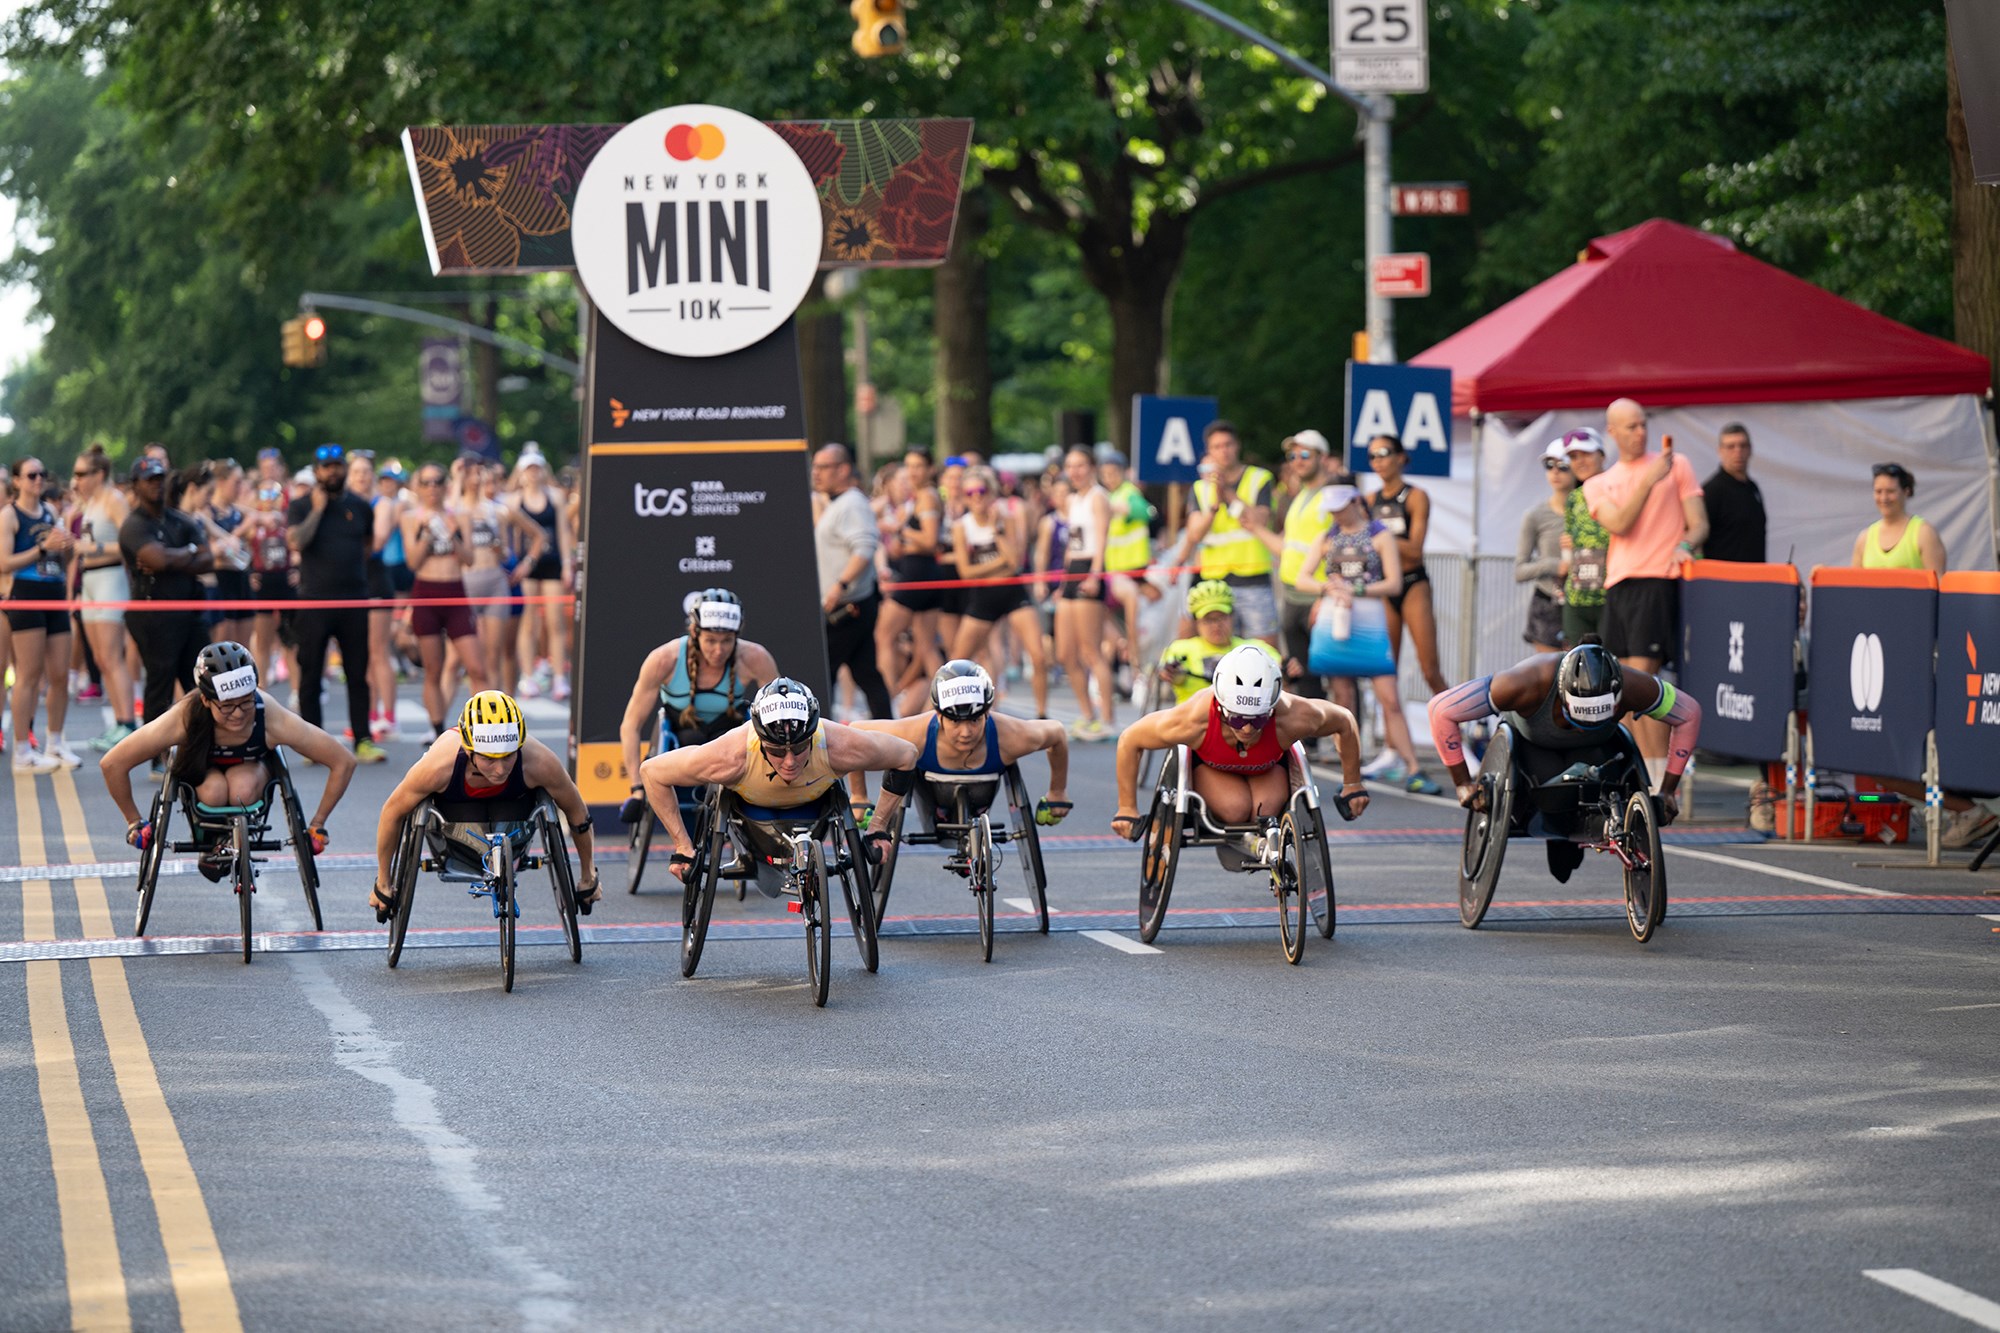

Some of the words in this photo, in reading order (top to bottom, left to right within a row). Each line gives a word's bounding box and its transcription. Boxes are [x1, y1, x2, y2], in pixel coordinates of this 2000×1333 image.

[1347, 6, 1410, 42] 25
[624, 174, 678, 190] NEW
[698, 173, 768, 189] YORK
[626, 200, 770, 295] MINI
[680, 299, 721, 320] 10K
[632, 409, 661, 421] NEW
[662, 408, 695, 421] YORK
[695, 406, 730, 420] ROAD
[730, 405, 787, 419] RUNNERS
[1352, 388, 1447, 451] AA
[1156, 416, 1196, 465] A
[691, 480, 724, 492] TATA
[634, 482, 688, 517] tcs
[691, 491, 766, 504] CONSULTANCY
[691, 503, 741, 516] SERVICES
[678, 557, 733, 573] Citizens
[220, 674, 254, 693] CLEAVER
[941, 684, 981, 699] DEDERICK
[761, 700, 807, 715] MCFADDEN
[1236, 695, 1262, 706] SOBIE
[1716, 683, 1755, 722] Citizens
[1573, 703, 1612, 715] WHEELER
[474, 733, 518, 744] WILLIAMSON
